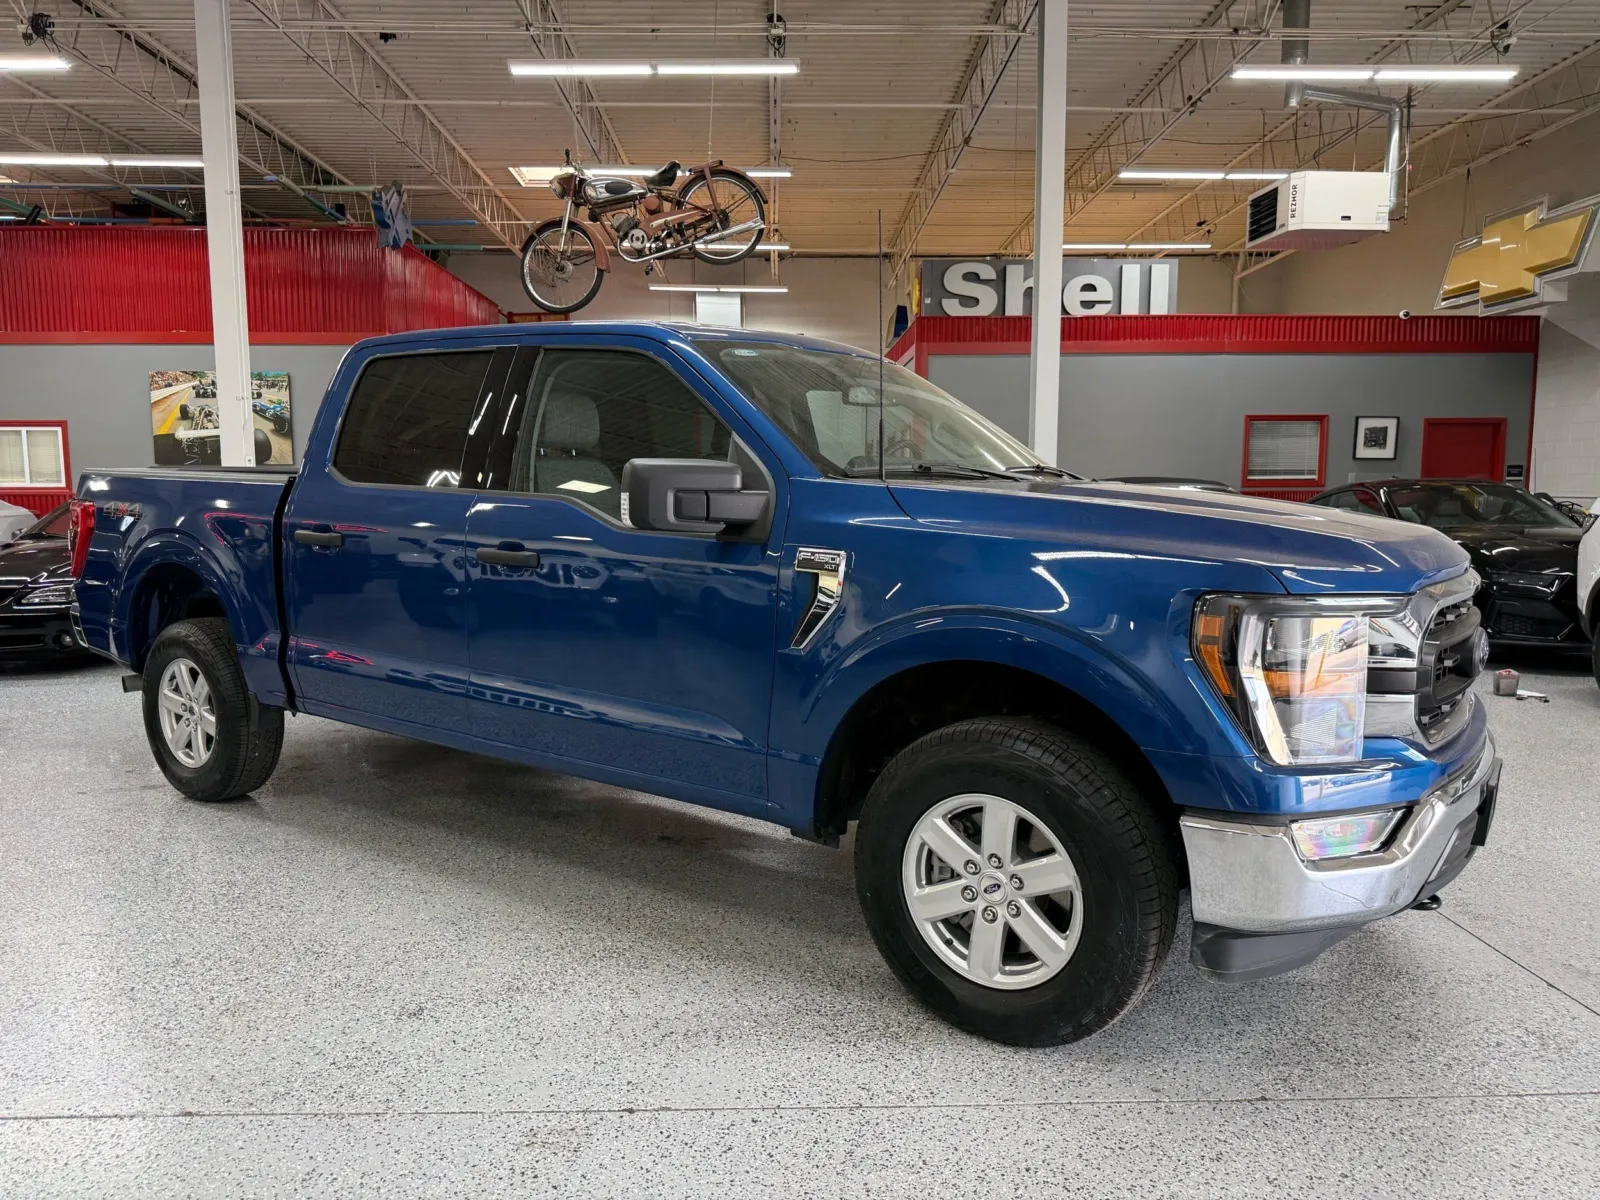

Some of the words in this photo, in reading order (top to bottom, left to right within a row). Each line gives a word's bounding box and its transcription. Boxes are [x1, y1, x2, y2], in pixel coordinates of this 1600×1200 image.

[1290, 184, 1298, 218] REZNOR
[941, 262, 1169, 316] Shell
[799, 552, 839, 563] F-150
